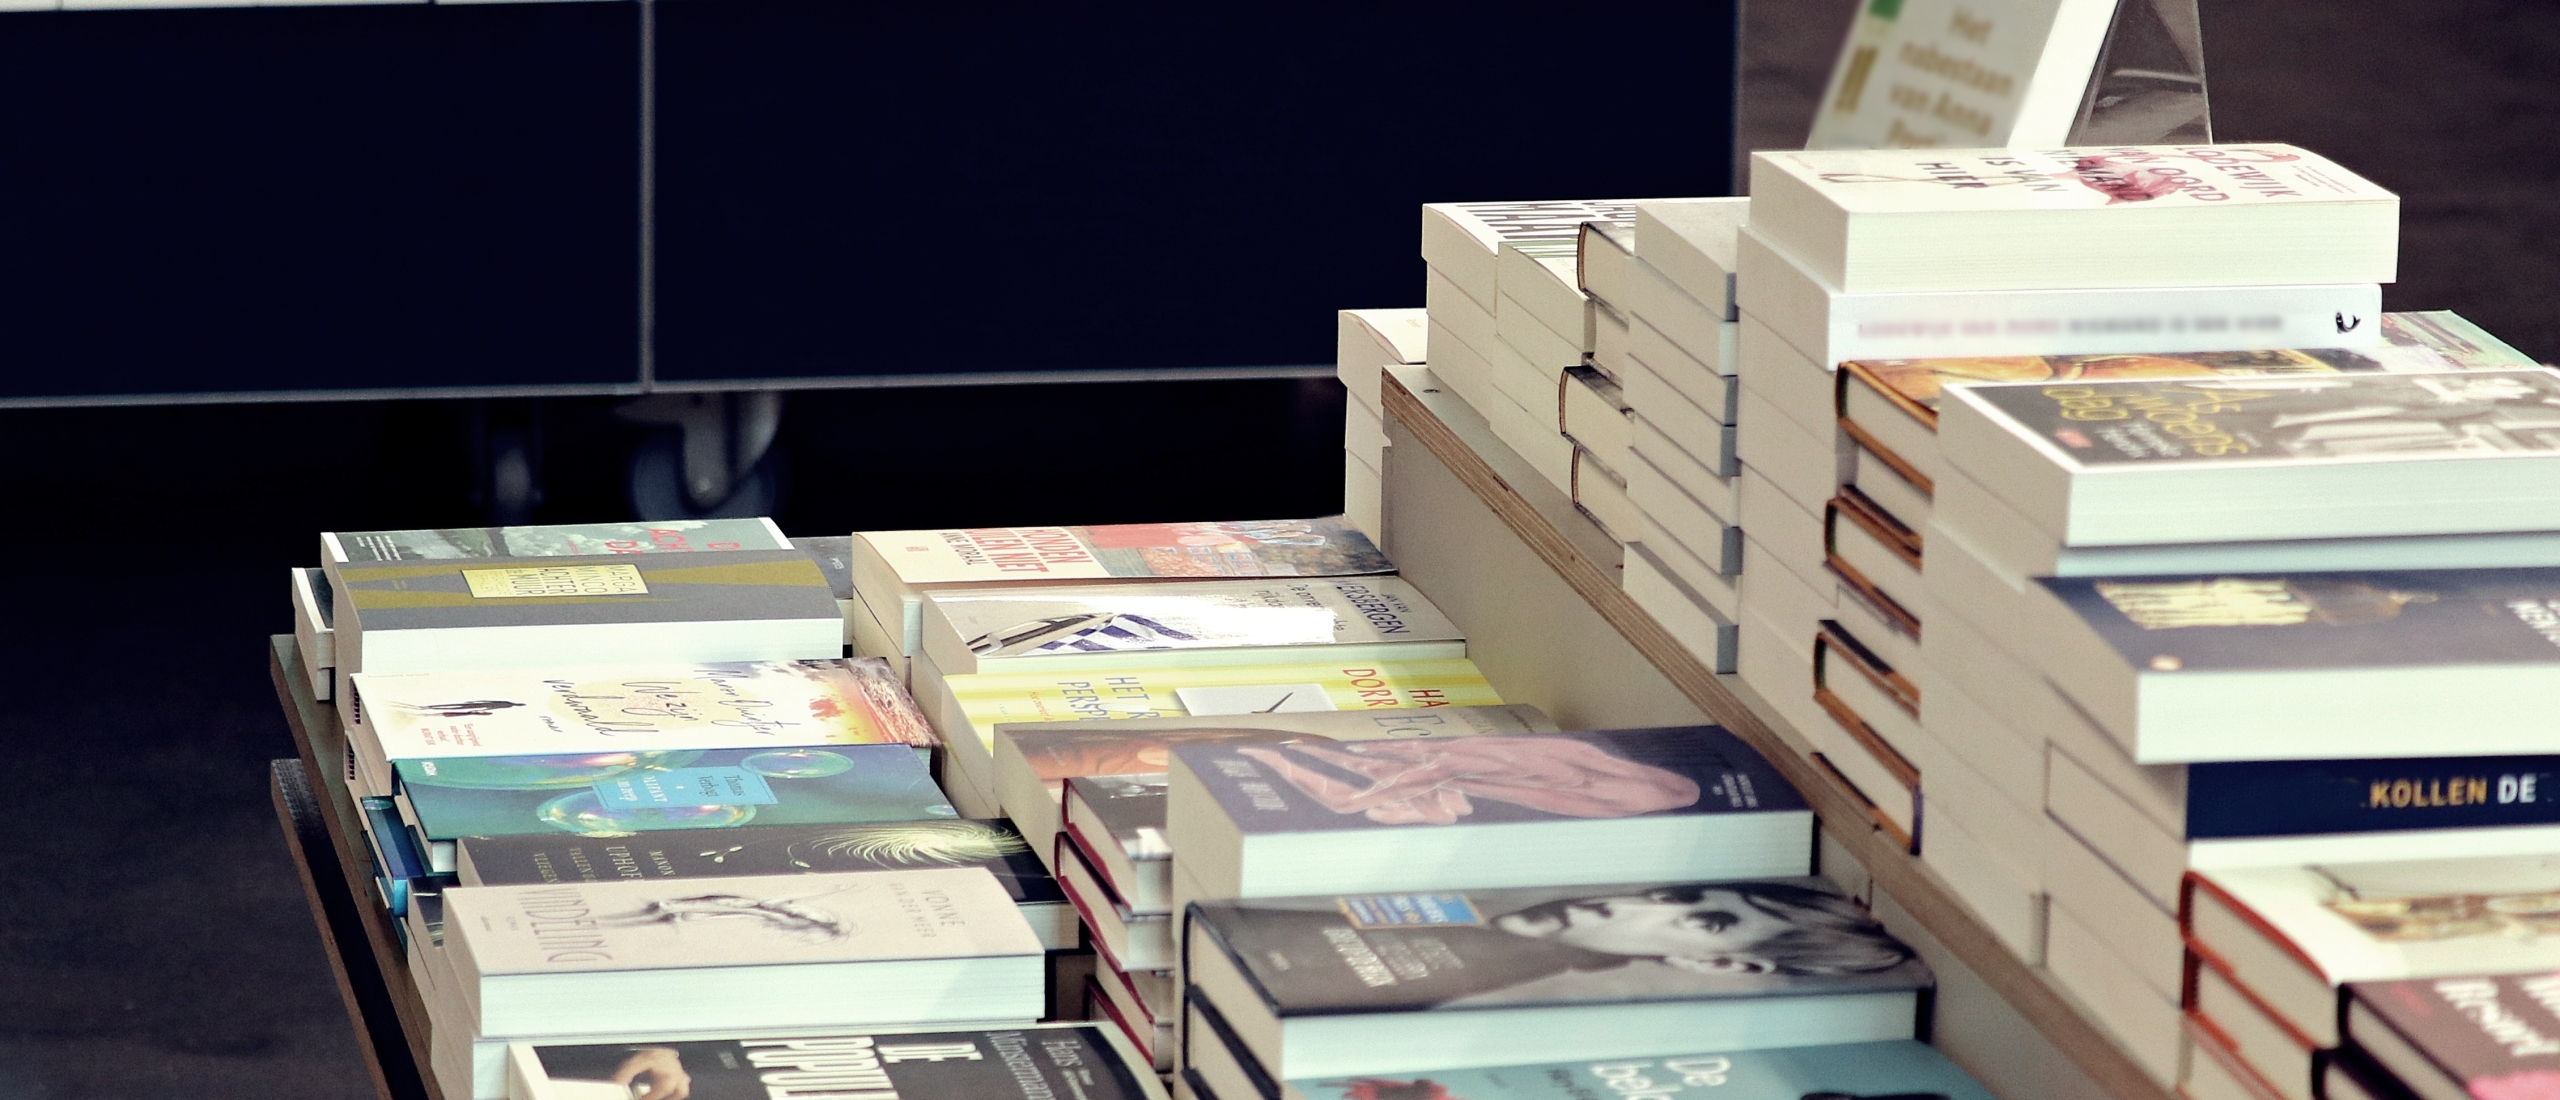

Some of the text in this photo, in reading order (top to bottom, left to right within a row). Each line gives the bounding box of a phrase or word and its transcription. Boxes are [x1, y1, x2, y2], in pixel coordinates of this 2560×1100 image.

[1915, 162, 1989, 189] HIER
[1979, 157, 2069, 192] IS VAN
[2148, 167, 2230, 202] OORD
[2174, 146, 2303, 198] LODEWIJK
[2042, 387, 2131, 422] dag
[950, 543, 990, 566] MORAAL
[1014, 528, 1094, 564] HONDEN
[986, 552, 1051, 573] NIET
[509, 574, 547, 597] MUUR
[537, 568, 579, 596] ACHTER
[572, 566, 609, 595] MINCO
[604, 565, 638, 594] MARGA
[621, 681, 703, 699] We
[1104, 676, 1151, 701] HET
[1342, 668, 1400, 708] DORR
[542, 679, 660, 737] verdwaald
[724, 775, 747, 797] Thomas
[650, 850, 677, 877] MANON
[877, 1040, 984, 1063] DE
[1040, 1039, 1084, 1067] Hans
[1665, 1056, 1732, 1088] De
